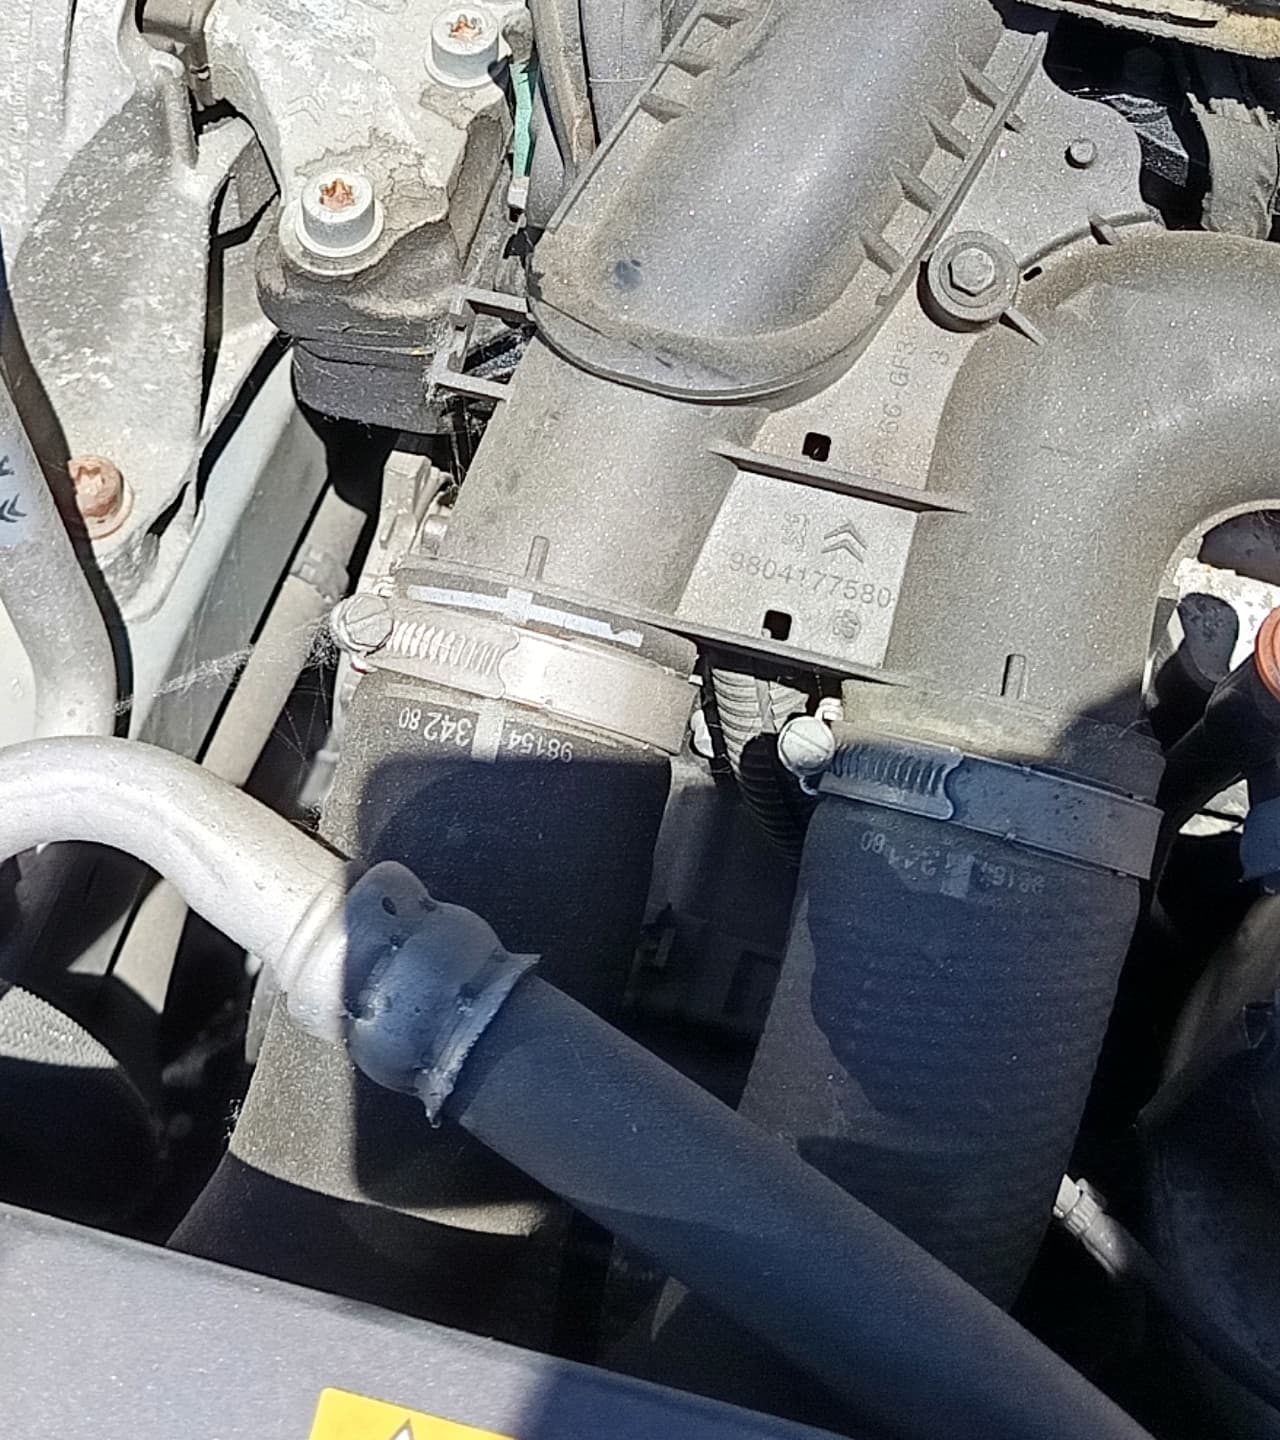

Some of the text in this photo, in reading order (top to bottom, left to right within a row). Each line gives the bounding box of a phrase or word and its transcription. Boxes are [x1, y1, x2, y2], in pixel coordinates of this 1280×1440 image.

[396, 705, 575, 764] 98154 342 80
